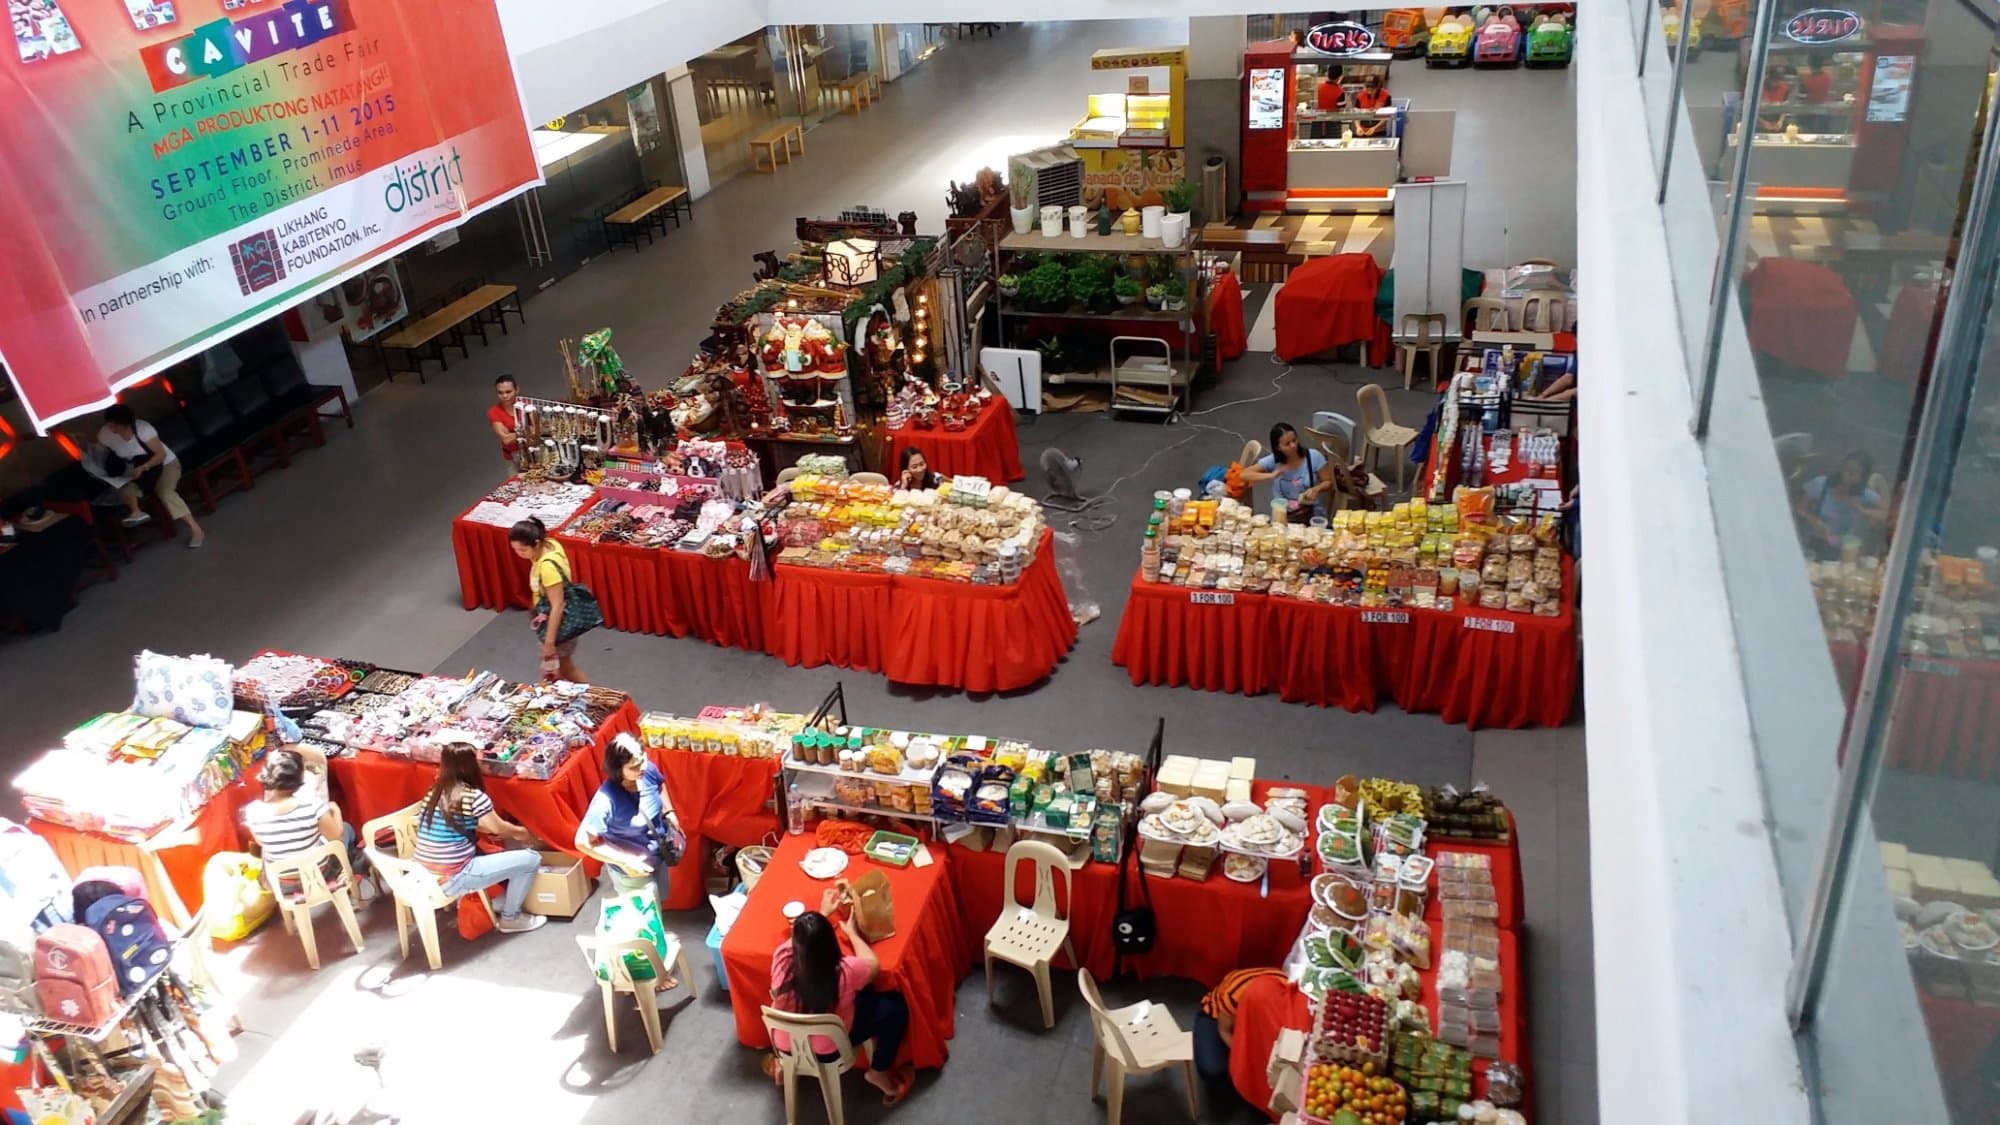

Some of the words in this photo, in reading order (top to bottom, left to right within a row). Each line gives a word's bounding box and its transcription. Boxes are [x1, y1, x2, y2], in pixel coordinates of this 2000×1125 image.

[165, 5, 334, 75] CAVITE
[128, 111, 144, 133] A
[153, 68, 270, 124] Provincial
[278, 49, 336, 82] Trade
[344, 38, 379, 62] Fair
[151, 133, 292, 200] SEPTEMBER
[301, 115, 340, 143] 1-11
[350, 94, 395, 126] 2015
[153, 128, 194, 160] MGA
[196, 97, 309, 137] PRODUKTONG
[163, 186, 226, 222] Ground
[283, 135, 361, 175] Prominede
[227, 202, 258, 222] The
[328, 160, 363, 181] Imus
[385, 145, 463, 213] district
[277, 206, 328, 238] LIKHANG
[282, 218, 346, 256] KABITENYO
[362, 223, 381, 239] Inc.
[80, 307, 96, 325] In
[98, 271, 183, 319] partnership
[183, 255, 215, 282] with:
[1200, 593, 1215, 603] FOR
[1371, 612, 1388, 622] FOR
